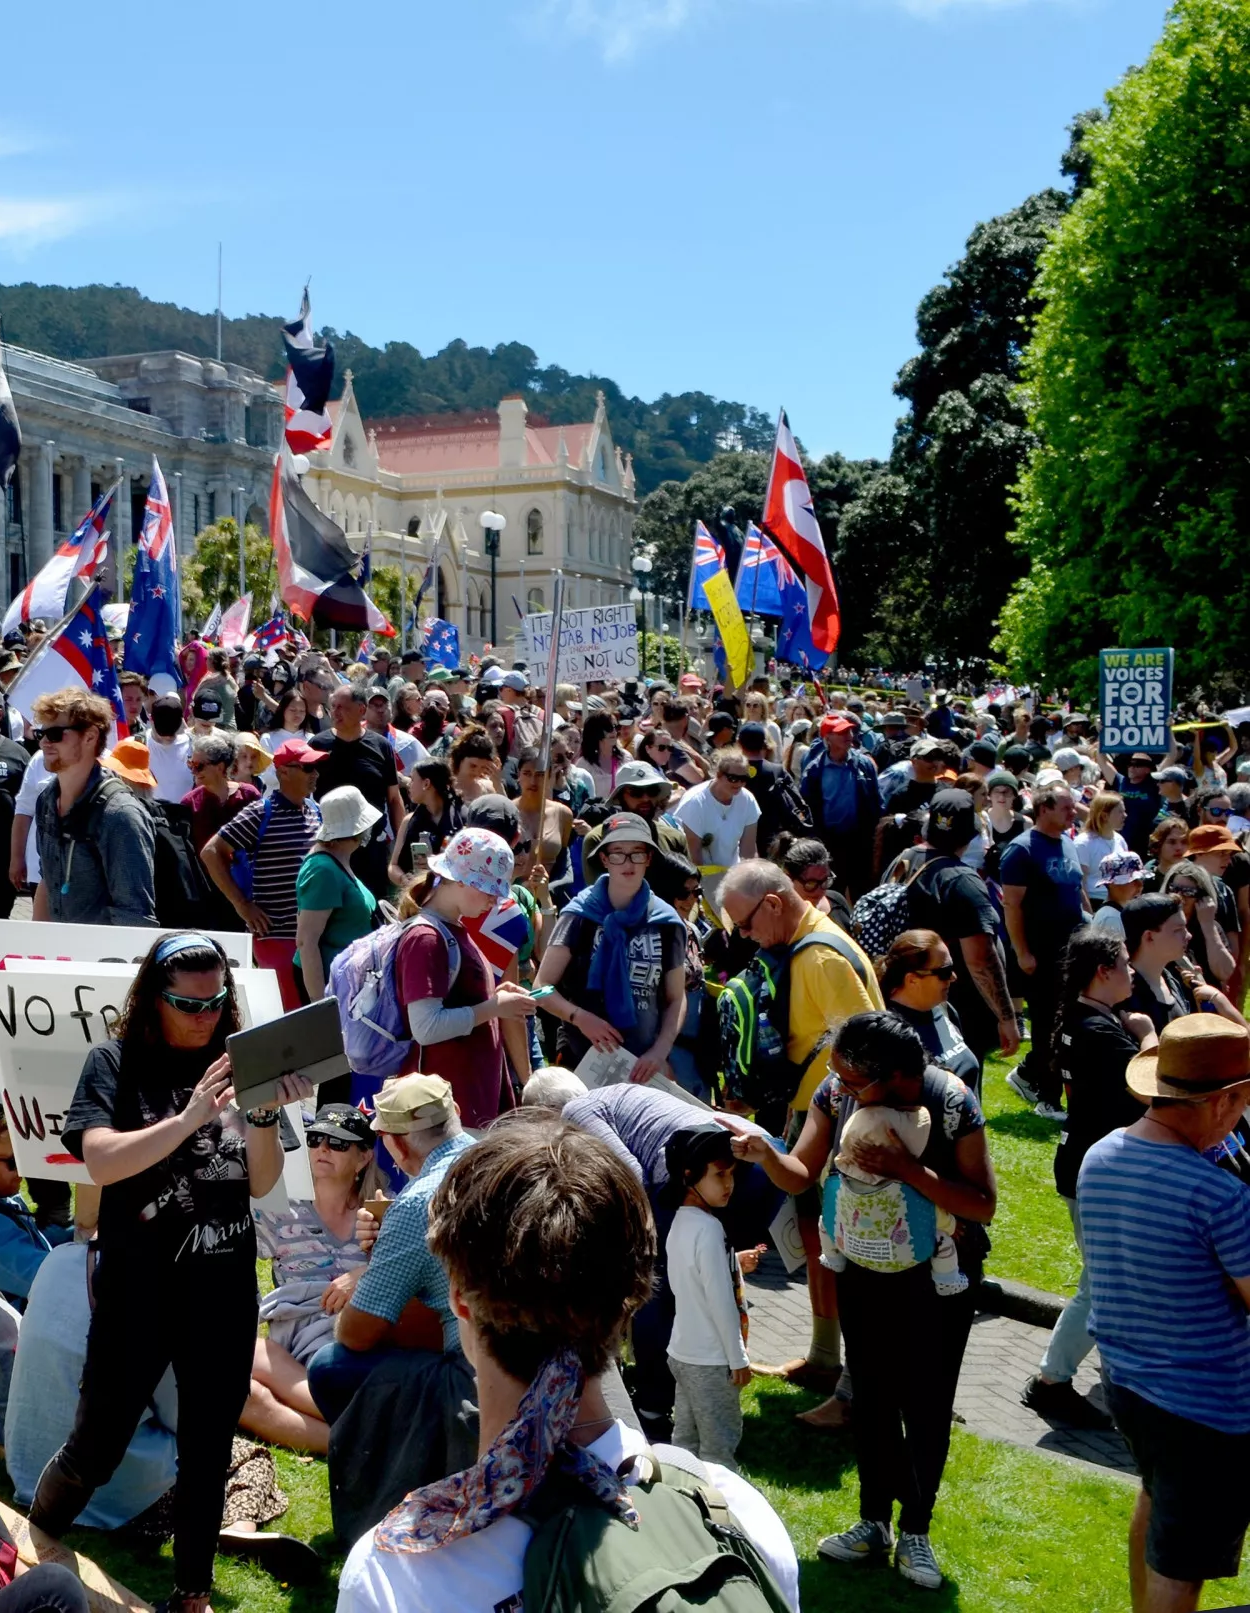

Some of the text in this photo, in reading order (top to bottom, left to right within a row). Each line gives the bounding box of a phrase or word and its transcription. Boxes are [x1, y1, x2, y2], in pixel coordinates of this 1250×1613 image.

[593, 605, 635, 625] RIGHT
[591, 626, 609, 644] NO
[610, 623, 637, 641] JOB
[566, 657, 579, 673] IS
[584, 649, 612, 670] NOT
[1104, 653, 1164, 667] WE ARE
[1104, 666, 1164, 681] VOICES
[1105, 681, 1165, 705] FOR
[1104, 705, 1165, 726] FREE
[1104, 726, 1165, 747] DOM
